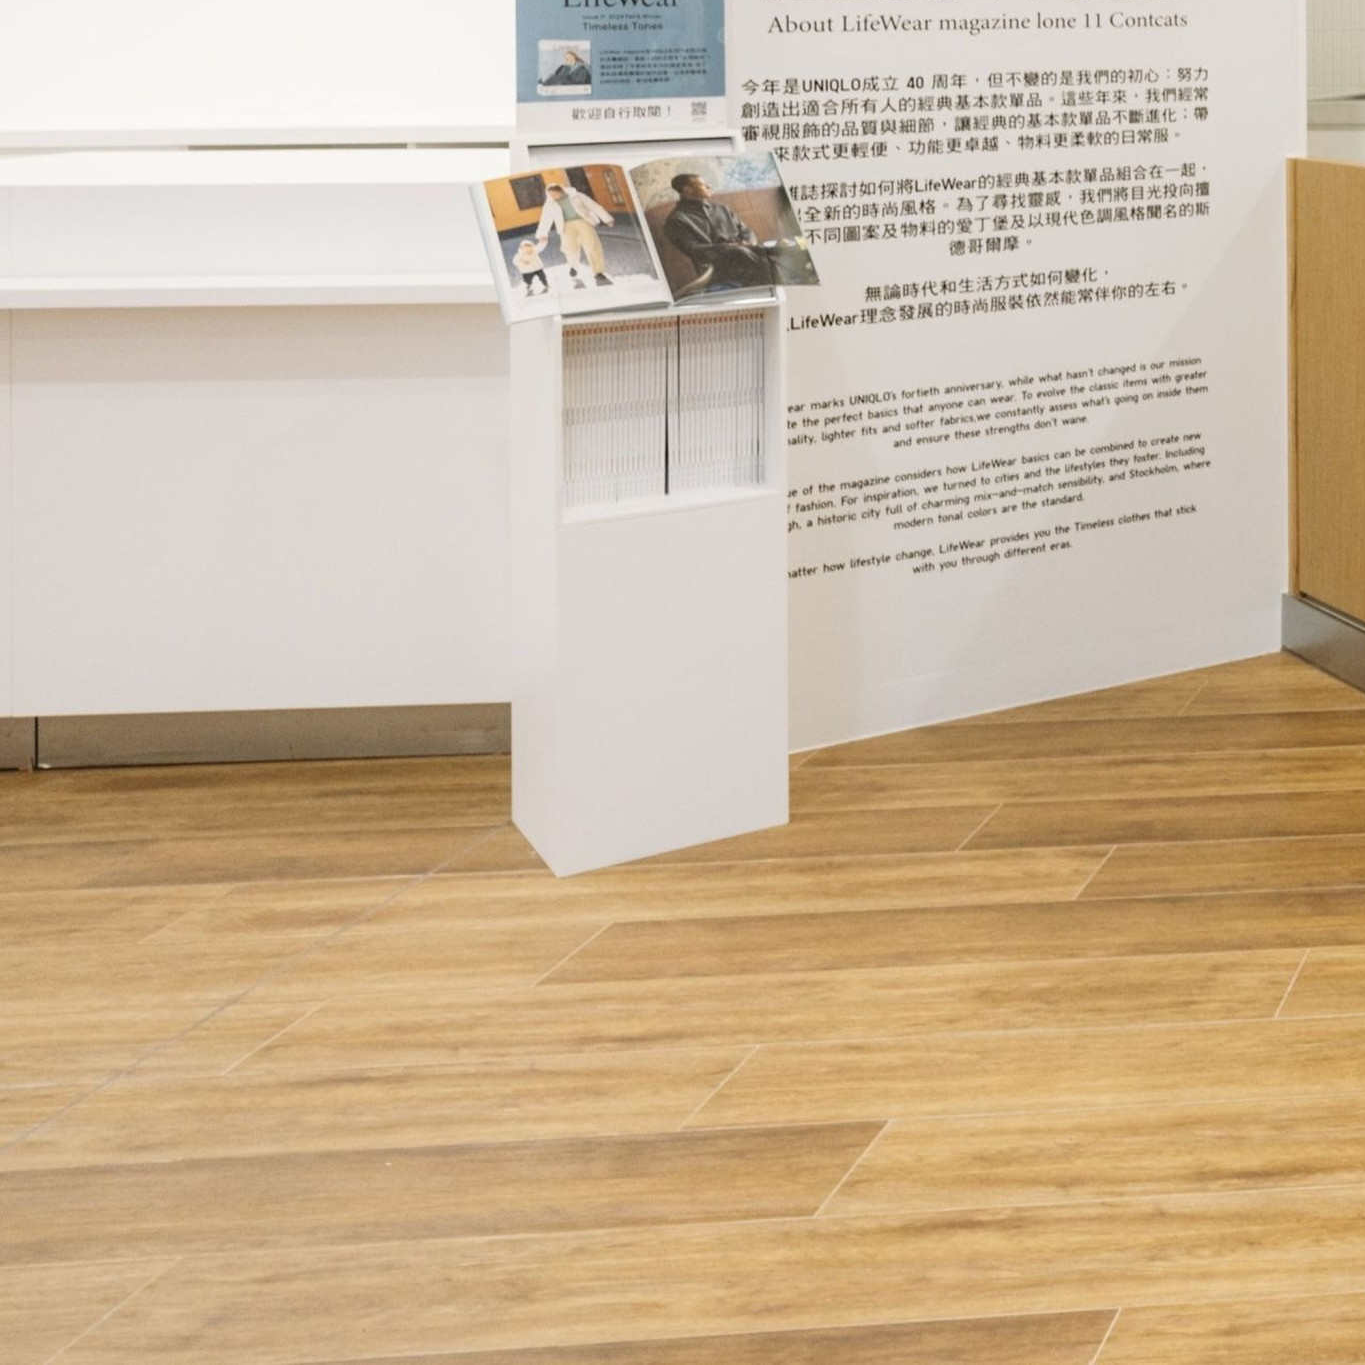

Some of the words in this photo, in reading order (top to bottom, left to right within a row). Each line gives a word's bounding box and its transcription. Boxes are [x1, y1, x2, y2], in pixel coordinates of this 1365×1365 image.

[582, 22, 629, 31] Timeless
[633, 21, 663, 31] Tones
[768, 15, 833, 33] About
[842, 13, 932, 32] LifeWear
[939, 13, 1031, 36] magazine
[743, 75, 899, 96] 今年是UNIQLO成立
[906, 76, 925, 89] 40
[798, 182, 1210, 223] 全新的時尚風格。為了尋找靈感，我們將目光投向擅
[949, 235, 1033, 257] 德哥爾摩。
[787, 280, 1188, 332] LifeWear理念發展的時尚服裝依然能常伴你的左右。
[788, 404, 806, 413] ear
[811, 398, 845, 410] marks
[849, 392, 897, 405] UNIQLO's
[902, 386, 940, 399] fortieth
[1008, 376, 1034, 387] while
[1039, 373, 1062, 383] what
[1067, 368, 1094, 378] hasn't
[1098, 365, 1136, 377] changed
[1140, 362, 1146, 371] is
[1151, 362, 1165, 370] our
[1170, 357, 1202, 367] mission
[803, 417, 819, 428] the
[824, 413, 863, 426] perfect
[868, 408, 898, 420] basics
[903, 404, 923, 414] that
[928, 401, 963, 413] anyone
[968, 398, 986, 407] can
[1022, 391, 1032, 400] To
[1037, 387, 1066, 398] evolve
[1070, 385, 1085, 394] the
[1089, 381, 1119, 392] classic
[1123, 378, 1147, 389] items
[1152, 374, 1172, 384] with
[1175, 370, 1208, 383] greater
[821, 428, 856, 443] lighter
[861, 426, 878, 436] fits
[882, 423, 901, 434] and
[905, 419, 934, 431] softer
[995, 404, 1044, 419] constantly
[1049, 401, 1077, 413] assess
[1082, 396, 1110, 408] what's
[1115, 393, 1139, 406] going
[1143, 392, 1154, 400] on
[1157, 387, 1181, 399] inside
[1186, 385, 1208, 395] them
[894, 438, 912, 448] and
[916, 434, 950, 445] ensure
[955, 429, 981, 440] these
[985, 423, 1030, 435] strengths
[1034, 418, 1057, 429] don't
[803, 486, 814, 496] of
[819, 483, 836, 493] the
[840, 475, 890, 491] magazine
[894, 467, 942, 482] considers
[946, 464, 967, 475] how
[972, 458, 1016, 471] LifeWear
[1022, 452, 1050, 464] basics
[1054, 450, 1071, 460] can
[1075, 447, 1086, 457] be
[1090, 440, 1134, 455] combined
[1138, 438, 1147, 448] to
[1151, 433, 1179, 446] create
[1183, 432, 1202, 441] new
[841, 495, 858, 506] For
[924, 484, 939, 494] we
[943, 478, 977, 491] turned
[981, 476, 990, 486] to
[995, 472, 1020, 483] cities
[1024, 468, 1041, 479] and
[1046, 465, 1061, 475] the
[1065, 460, 1105, 474] lifestyles
[1110, 456, 1129, 467] they
[1165, 446, 1205, 459] Including
[807, 519, 813, 528] a
[818, 512, 857, 526] historic
[861, 509, 881, 521] city
[886, 504, 903, 515] full
[907, 502, 918, 512] of
[922, 495, 970, 511] charming
[1109, 472, 1126, 482] and
[1184, 459, 1211, 471] where
[894, 517, 934, 530] modern
[938, 512, 963, 524] tonal
[968, 507, 998, 519] colors
[1002, 503, 1017, 512] are
[1022, 501, 1037, 510] the
[823, 562, 845, 573] how
[851, 554, 891, 569] lifestyle
[939, 539, 985, 555] LifeWear
[990, 532, 1030, 547] provides
[1034, 529, 1051, 540] you
[1055, 525, 1070, 535] the
[1075, 519, 1115, 531] Timeless
[1118, 512, 1151, 525] clothes
[1155, 508, 1172, 519] that
[1176, 504, 1197, 515] stick
[913, 563, 935, 573] with
[940, 559, 957, 570] you
[962, 551, 1000, 566] through
[1004, 544, 1046, 559] different
